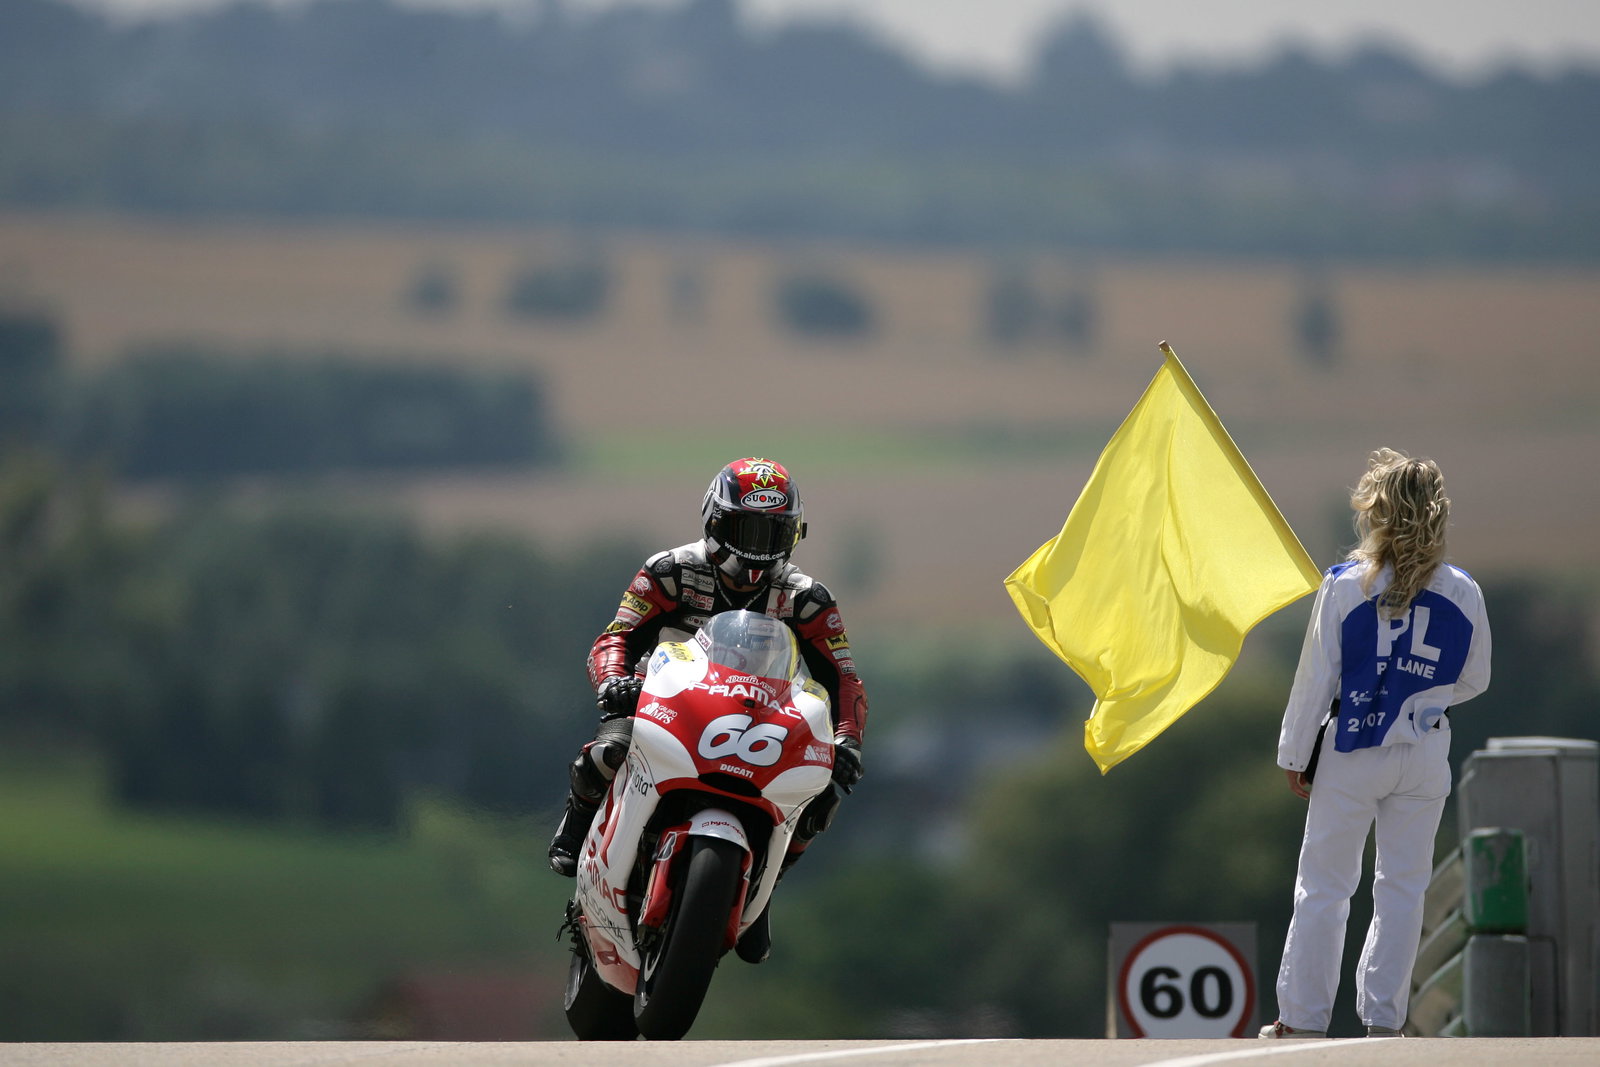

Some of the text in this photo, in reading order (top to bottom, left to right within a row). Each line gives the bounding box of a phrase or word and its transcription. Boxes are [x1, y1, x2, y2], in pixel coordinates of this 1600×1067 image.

[724, 541, 786, 560] www.alex66.com
[1396, 657, 1437, 680] LANE
[688, 680, 802, 720] PRAMAC
[653, 711, 675, 725] MPS
[1347, 711, 1387, 733] 207
[697, 713, 789, 767] 66
[720, 763, 754, 779] DUCATI
[1140, 965, 1234, 1019] 60
